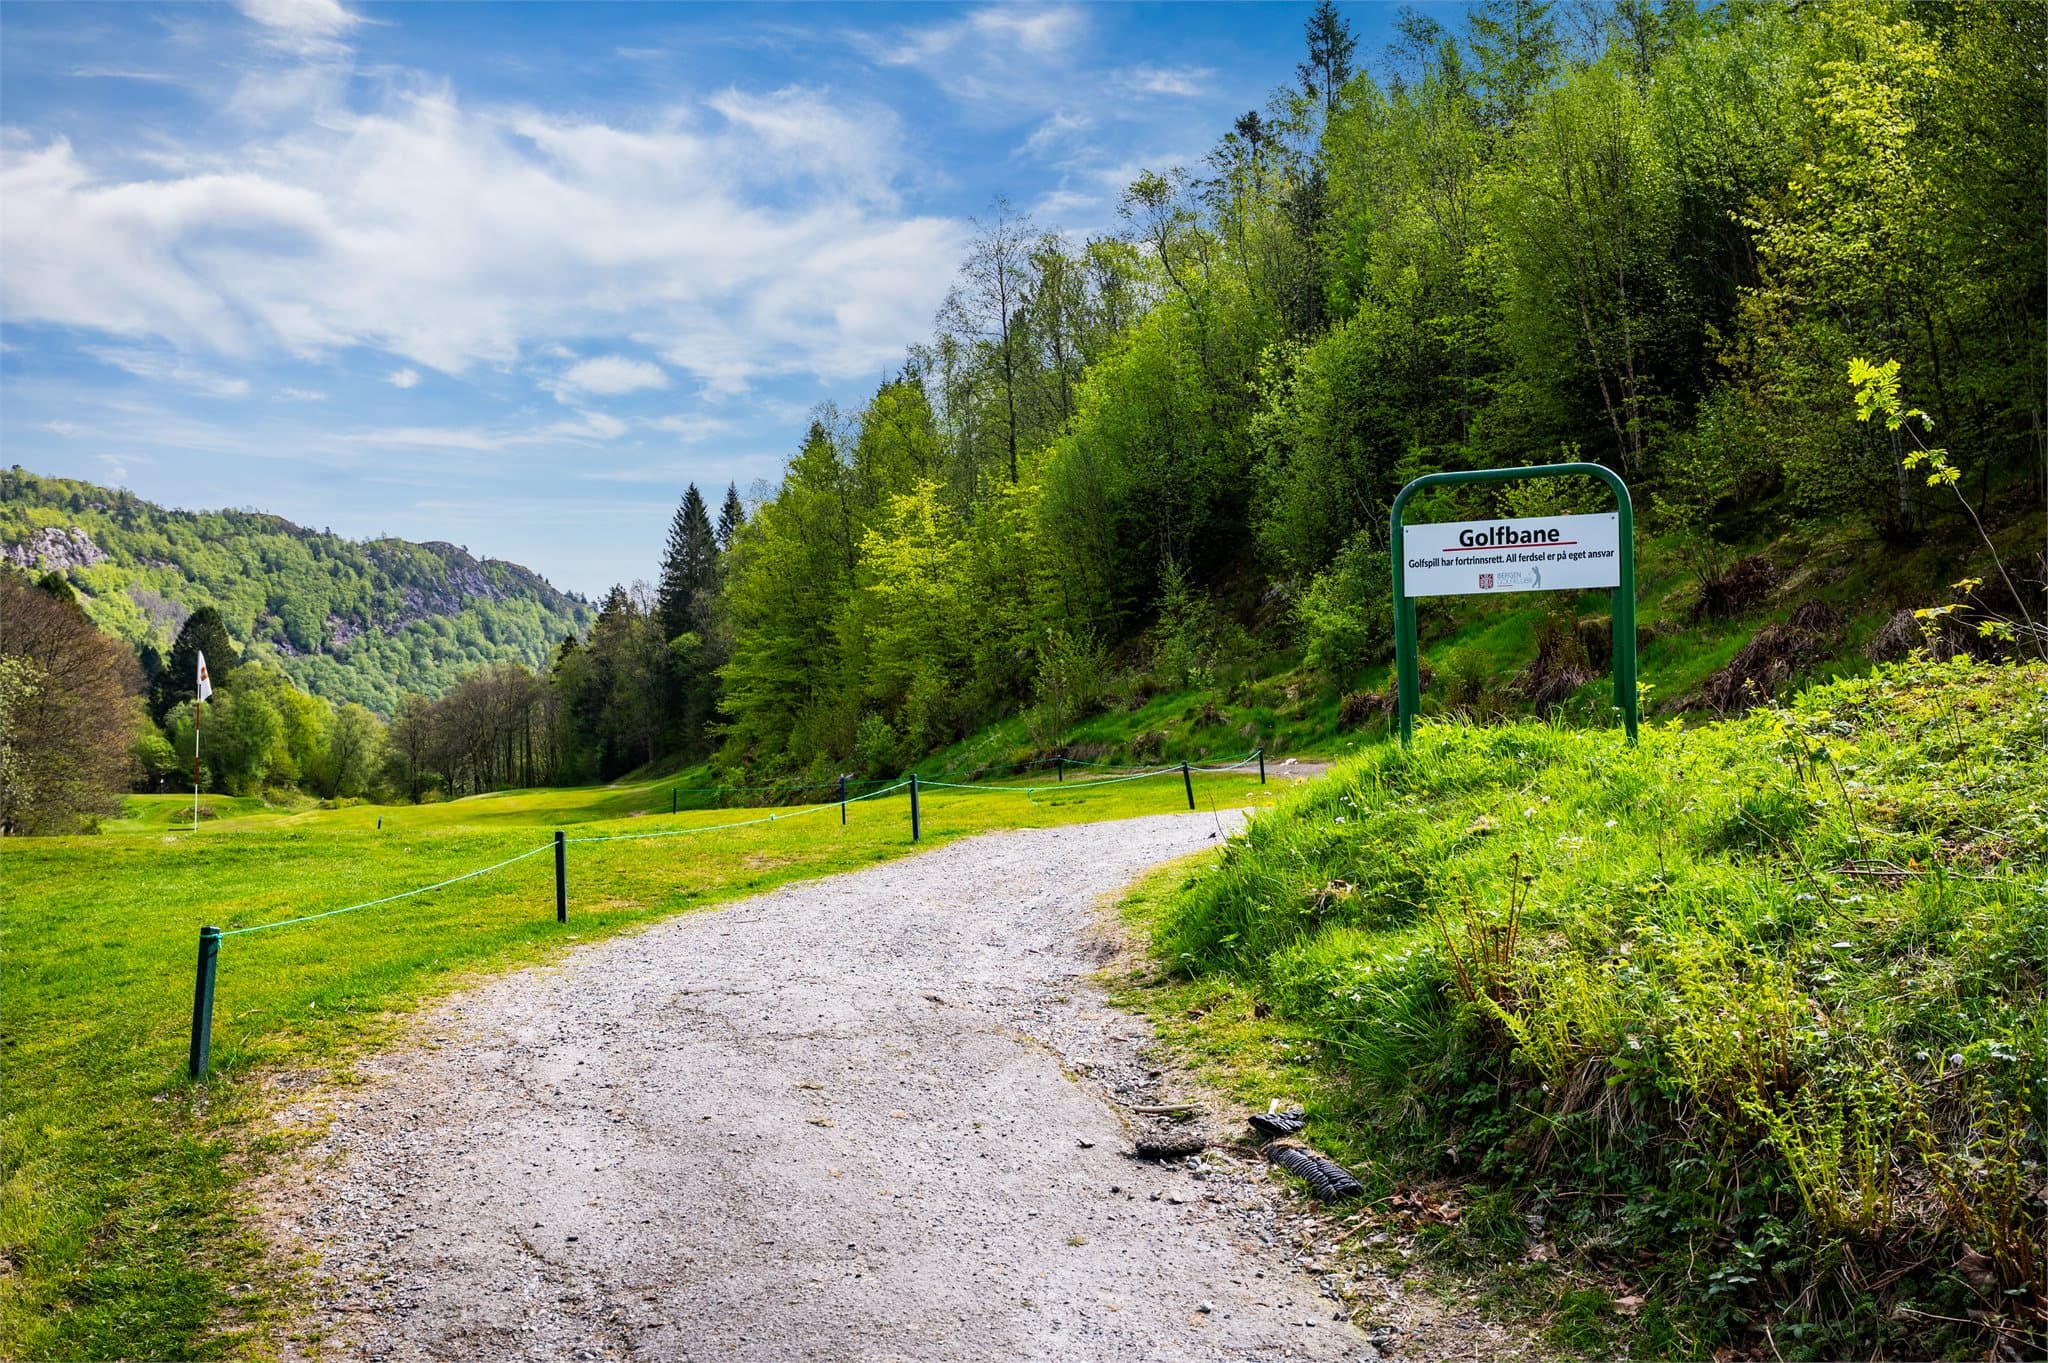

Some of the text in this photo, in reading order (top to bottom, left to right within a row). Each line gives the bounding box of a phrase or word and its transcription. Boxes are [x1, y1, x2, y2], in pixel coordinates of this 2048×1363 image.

[1459, 526, 1560, 547] Golfbane
[1408, 549, 1615, 569] Golfspill har fortrinnsrett. All ferdsel er på eget ansvar
